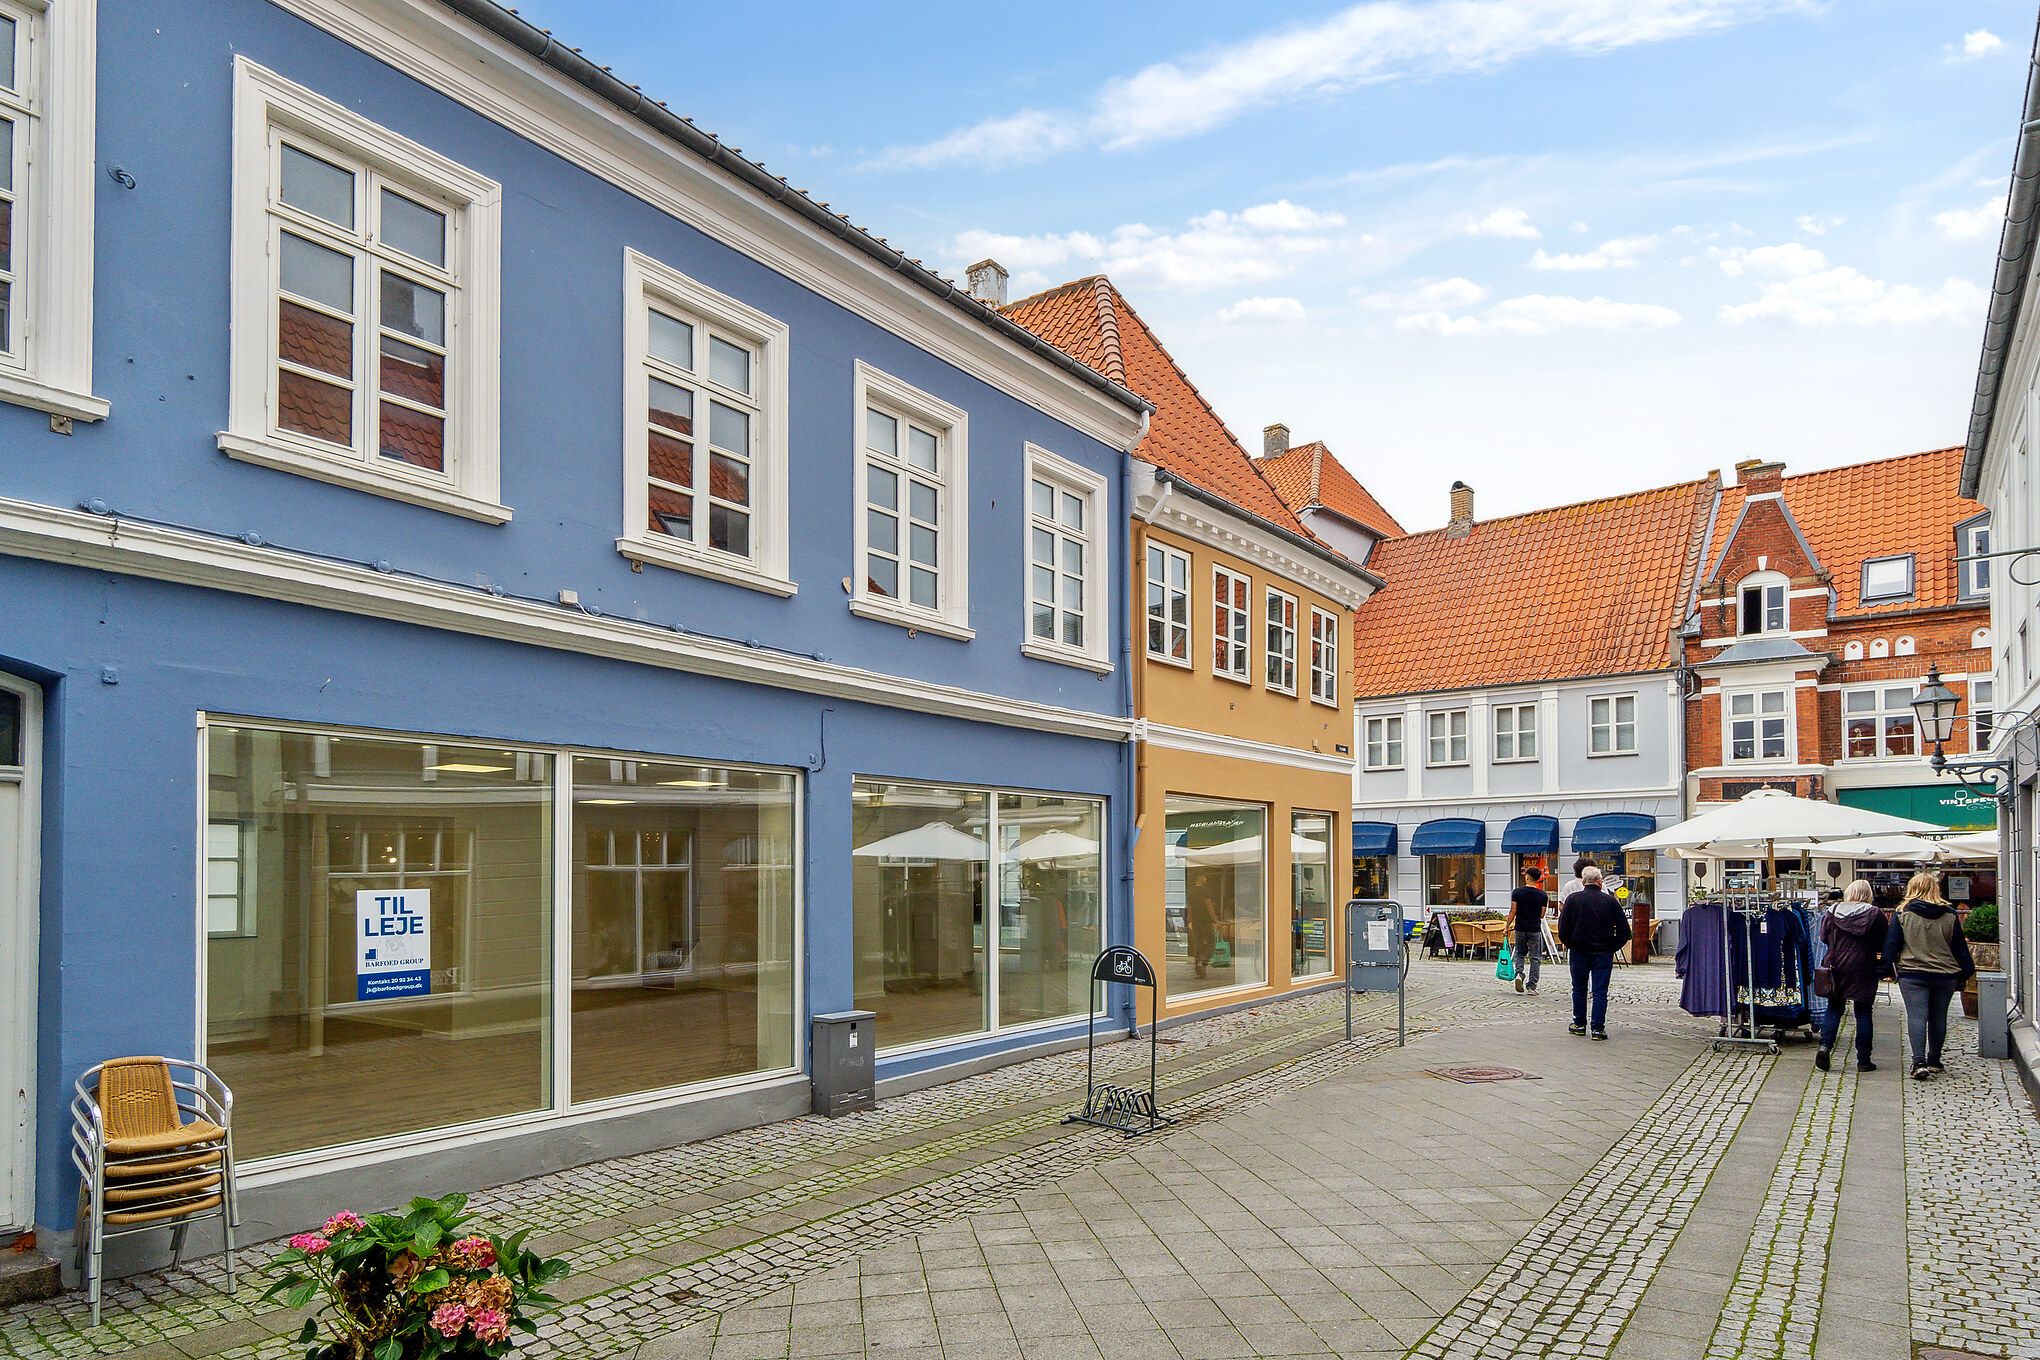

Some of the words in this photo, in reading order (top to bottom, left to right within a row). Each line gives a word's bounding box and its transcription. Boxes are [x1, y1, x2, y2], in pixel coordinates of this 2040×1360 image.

[375, 896, 414, 915] TIL
[364, 916, 424, 937] LEJE
[365, 960, 399, 968] BARFOED
[366, 983, 423, 994] jk@barfoedgroup.dk
